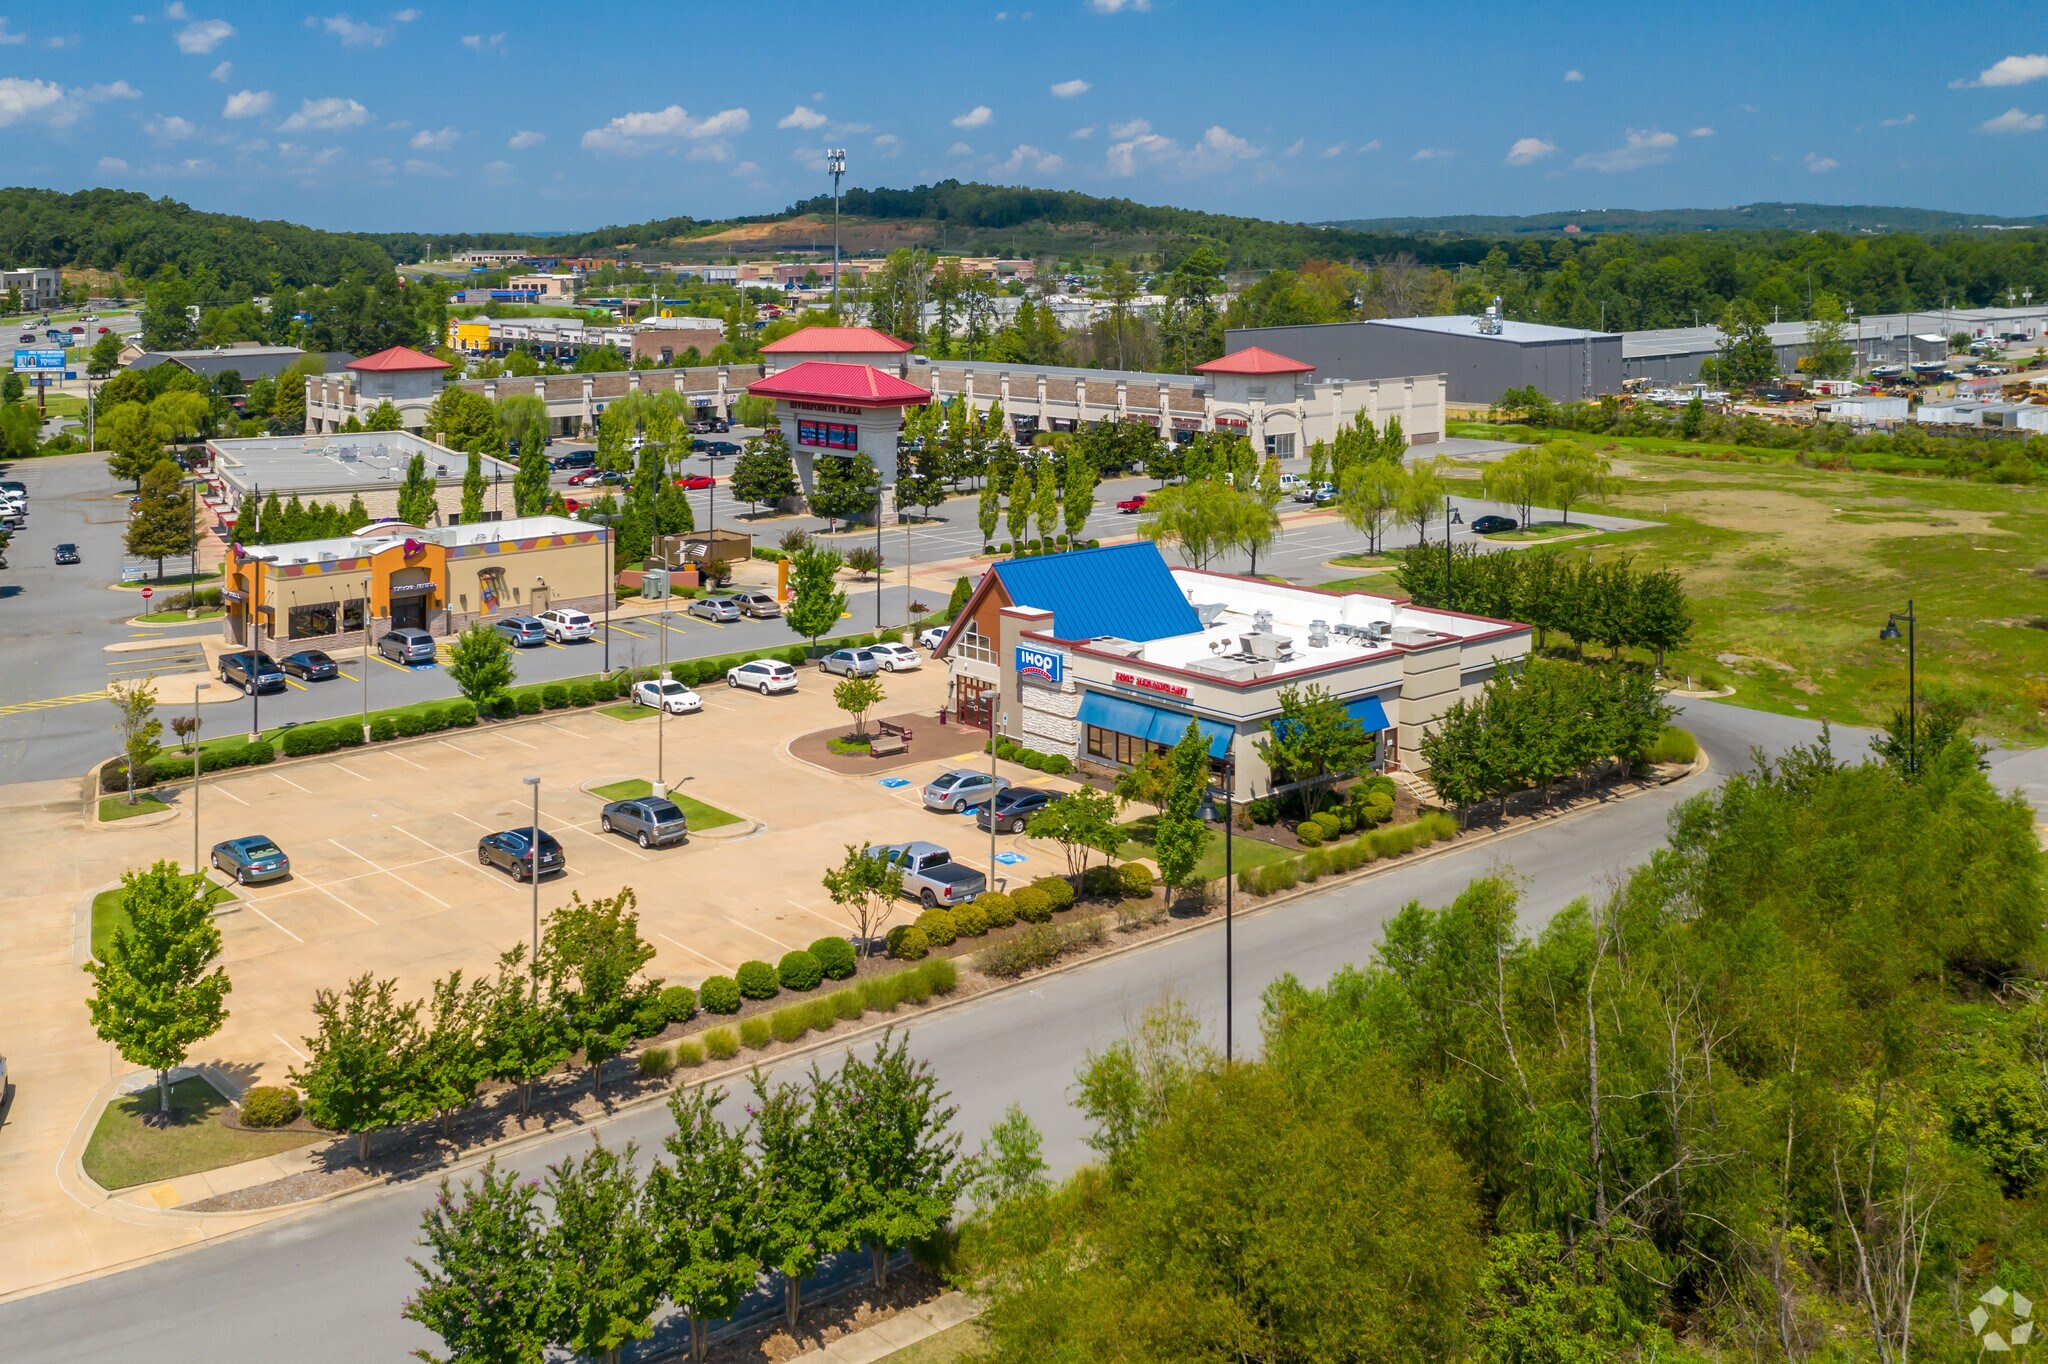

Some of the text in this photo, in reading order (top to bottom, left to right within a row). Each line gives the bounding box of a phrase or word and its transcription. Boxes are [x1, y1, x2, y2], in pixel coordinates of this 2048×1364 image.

[790, 400, 862, 415] RIVERPOINTE PLAZA
[1021, 650, 1053, 672] IHOP
